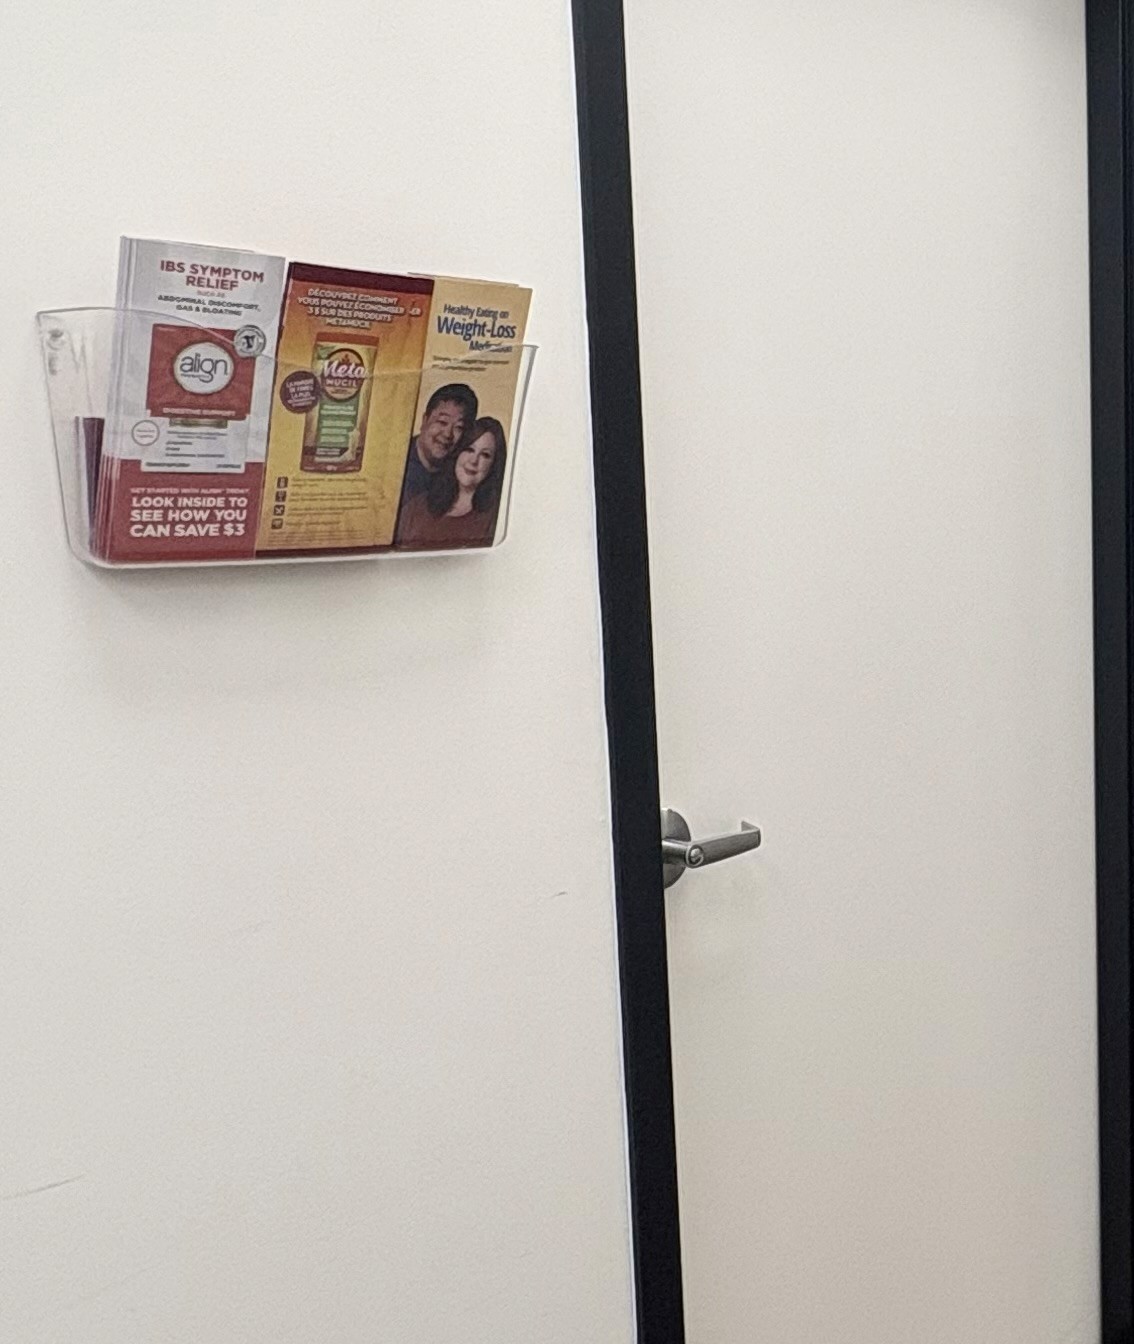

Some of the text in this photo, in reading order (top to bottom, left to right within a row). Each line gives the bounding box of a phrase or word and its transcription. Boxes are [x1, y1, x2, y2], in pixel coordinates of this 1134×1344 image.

[160, 259, 264, 283] IBS SYMPTOM
[185, 275, 239, 291] RELIEF
[443, 303, 475, 319] Healthy
[437, 315, 517, 341] Weight-Loss
[180, 353, 228, 383] align
[325, 378, 357, 388] MUCIL
[132, 497, 248, 507] LOOK INSIDE TO
[130, 509, 247, 522] SEE HOW YOU
[130, 523, 245, 537] CAN SAVE $3
